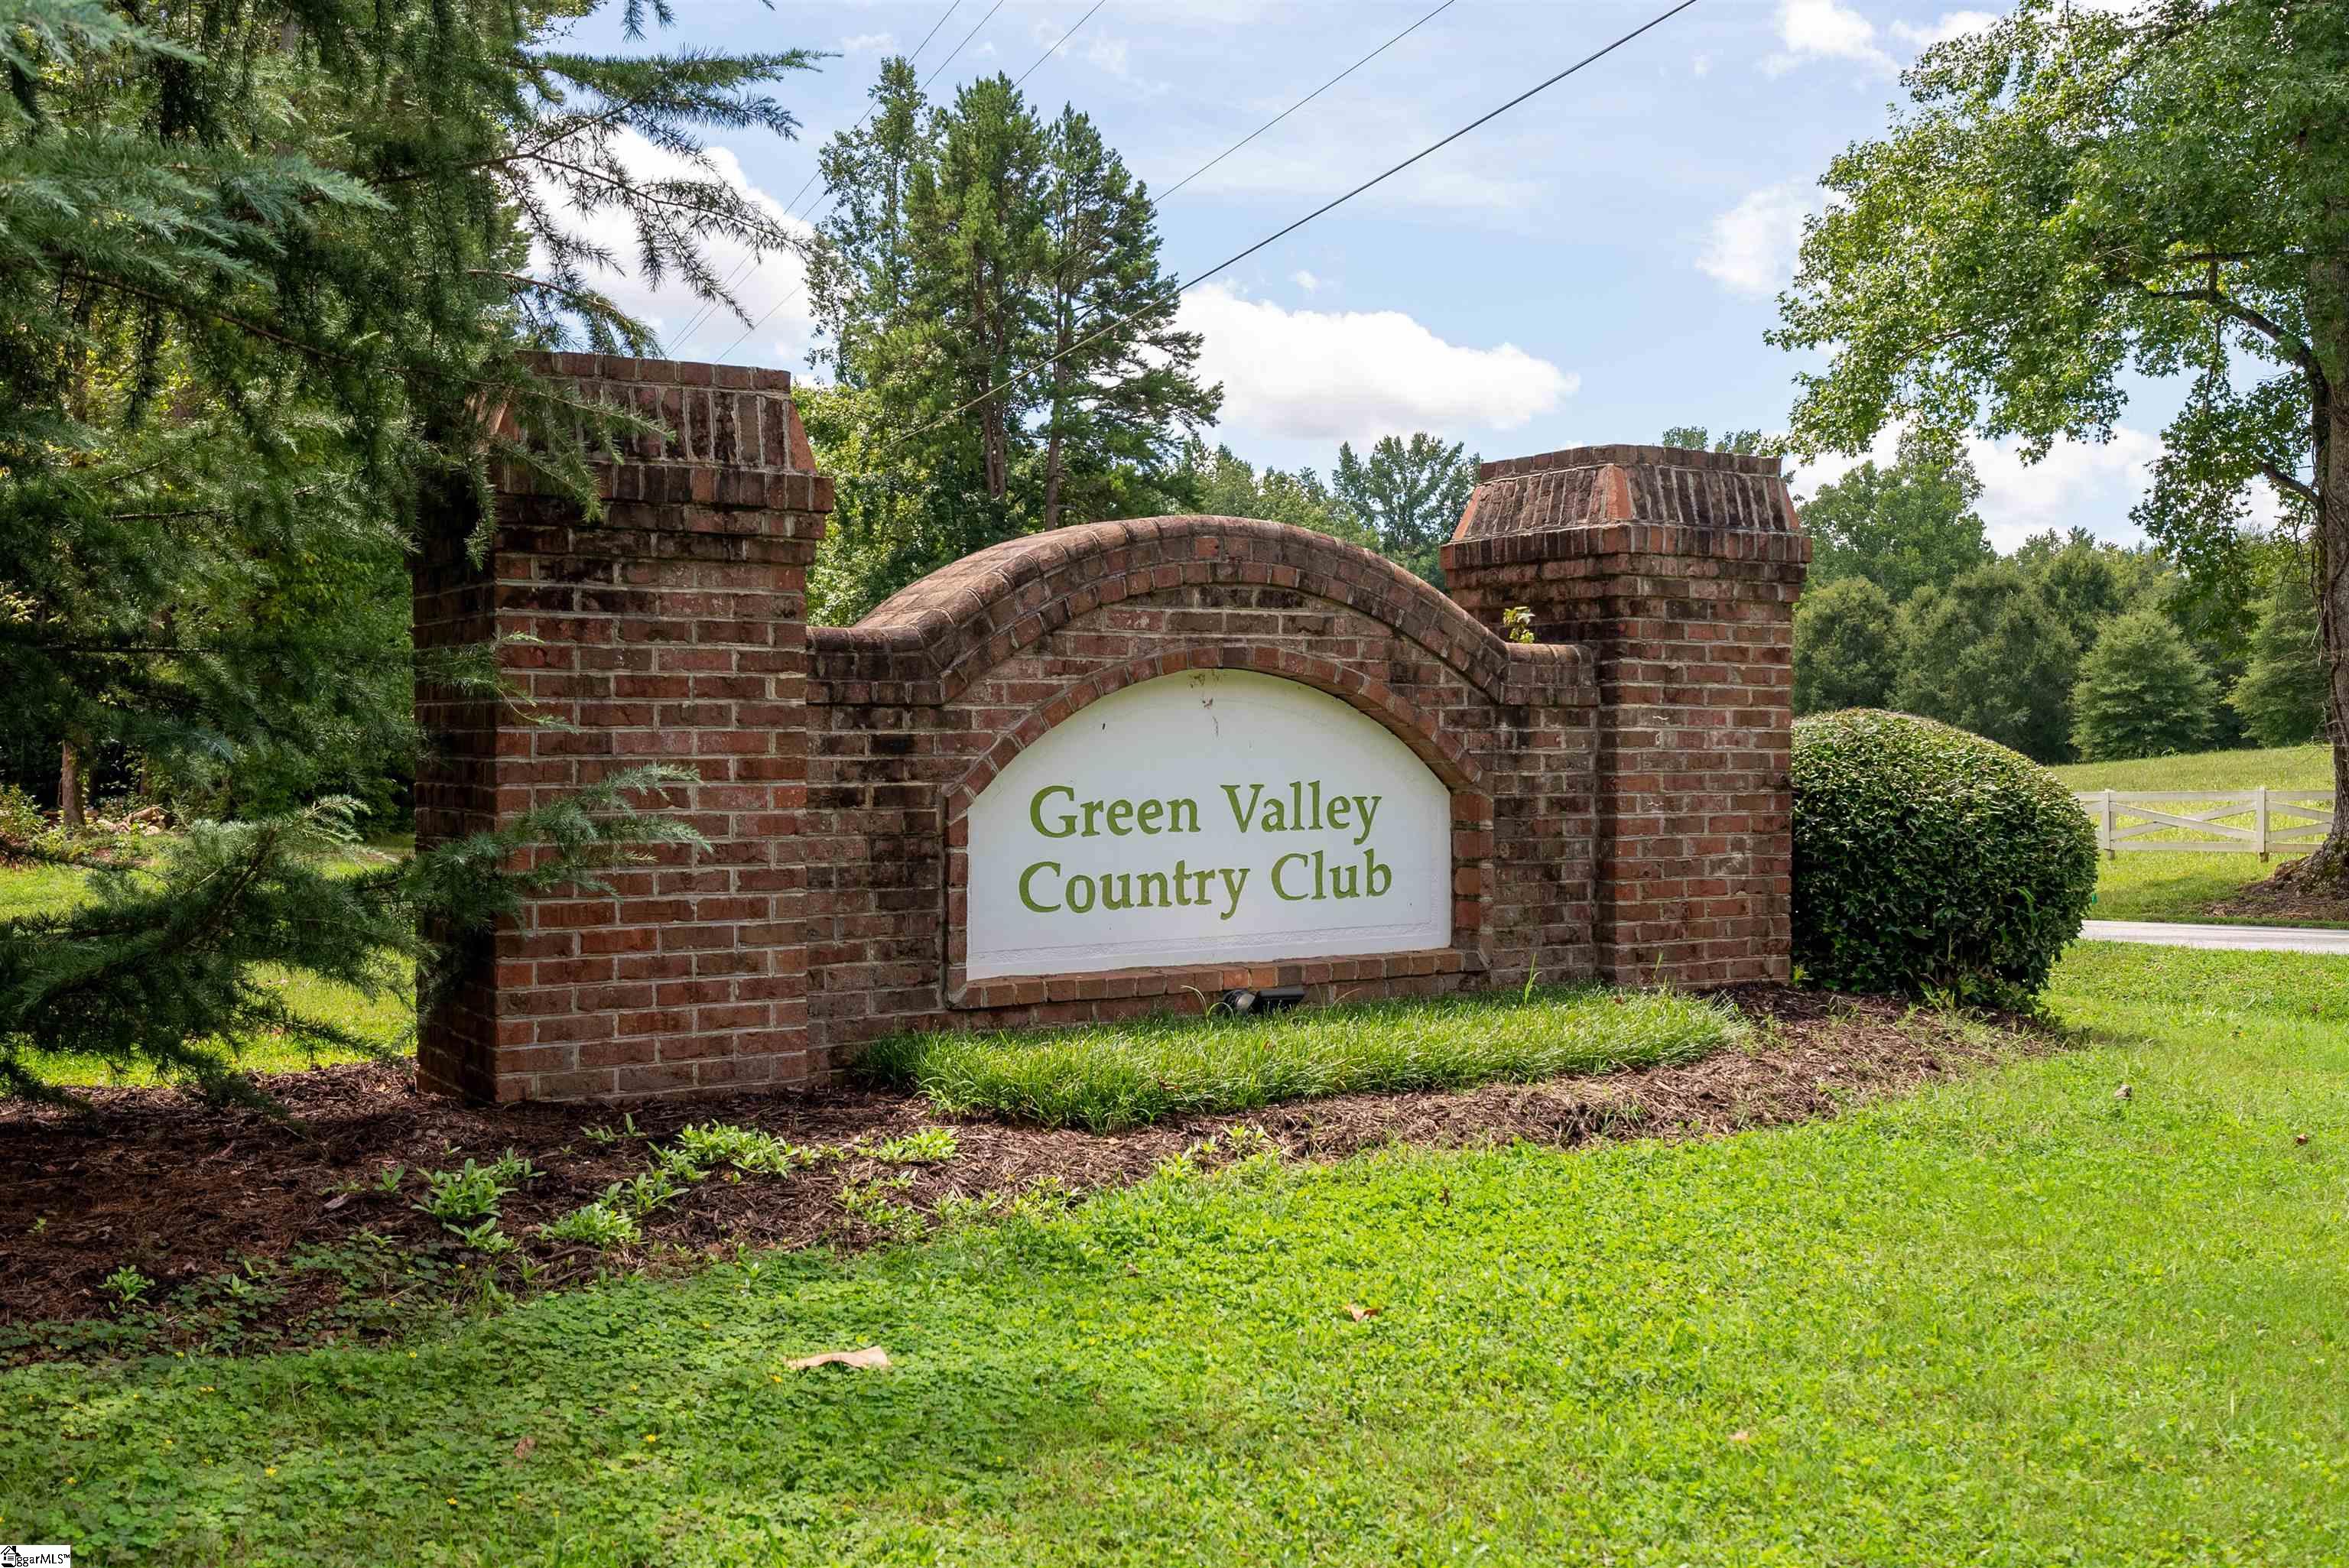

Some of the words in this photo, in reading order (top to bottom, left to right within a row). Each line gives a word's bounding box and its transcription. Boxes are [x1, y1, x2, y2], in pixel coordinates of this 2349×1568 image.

[1029, 784, 1201, 839] Green
[1220, 780, 1382, 846] Valley
[1019, 859, 1251, 920] Country
[1270, 848, 1392, 901] Club
